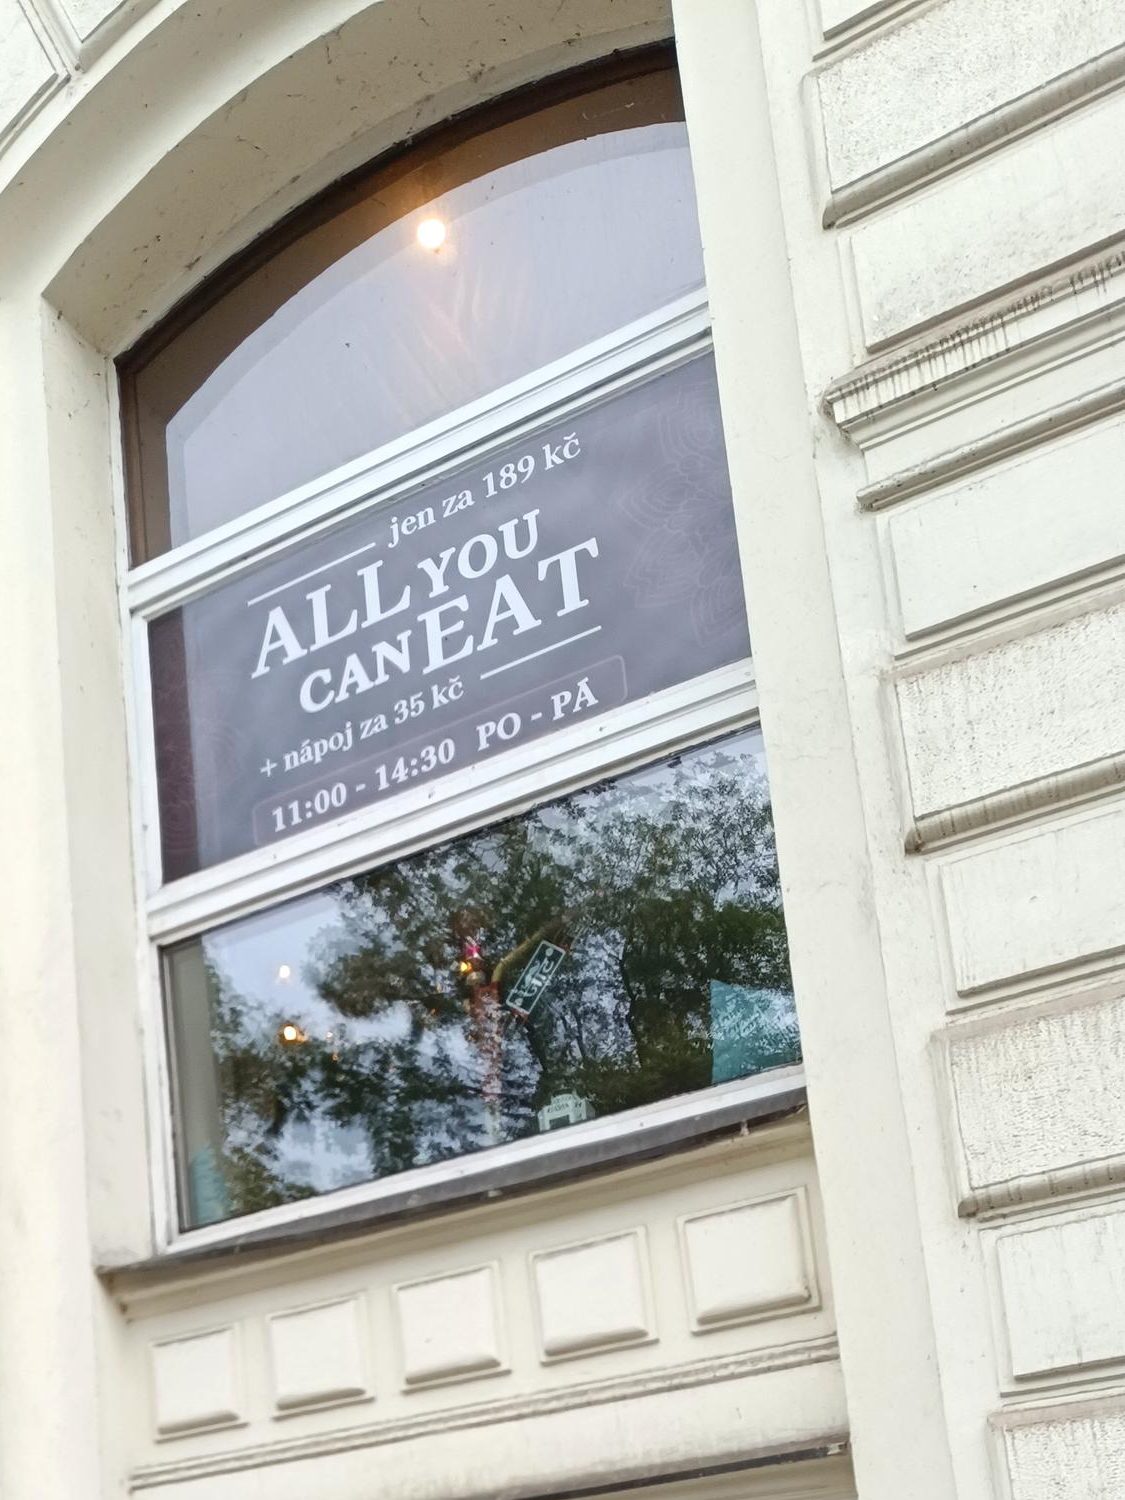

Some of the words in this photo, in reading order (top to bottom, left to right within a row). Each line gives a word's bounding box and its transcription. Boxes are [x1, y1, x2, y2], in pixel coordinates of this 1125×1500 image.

[387, 507, 435, 548] jen
[442, 489, 475, 520] za
[482, 455, 535, 498] 189
[542, 432, 582, 473] kč
[251, 558, 412, 680] ALL
[417, 508, 541, 598] YOU
[297, 629, 413, 714] CAN
[416, 537, 600, 676] EAT
[271, 781, 347, 833] 11:00
[373, 738, 456, 792] 14:30
[476, 711, 522, 752] PO
[282, 723, 355, 771] nápoj
[359, 711, 389, 740] za
[392, 684, 426, 726] 35
[431, 676, 466, 711] kč
